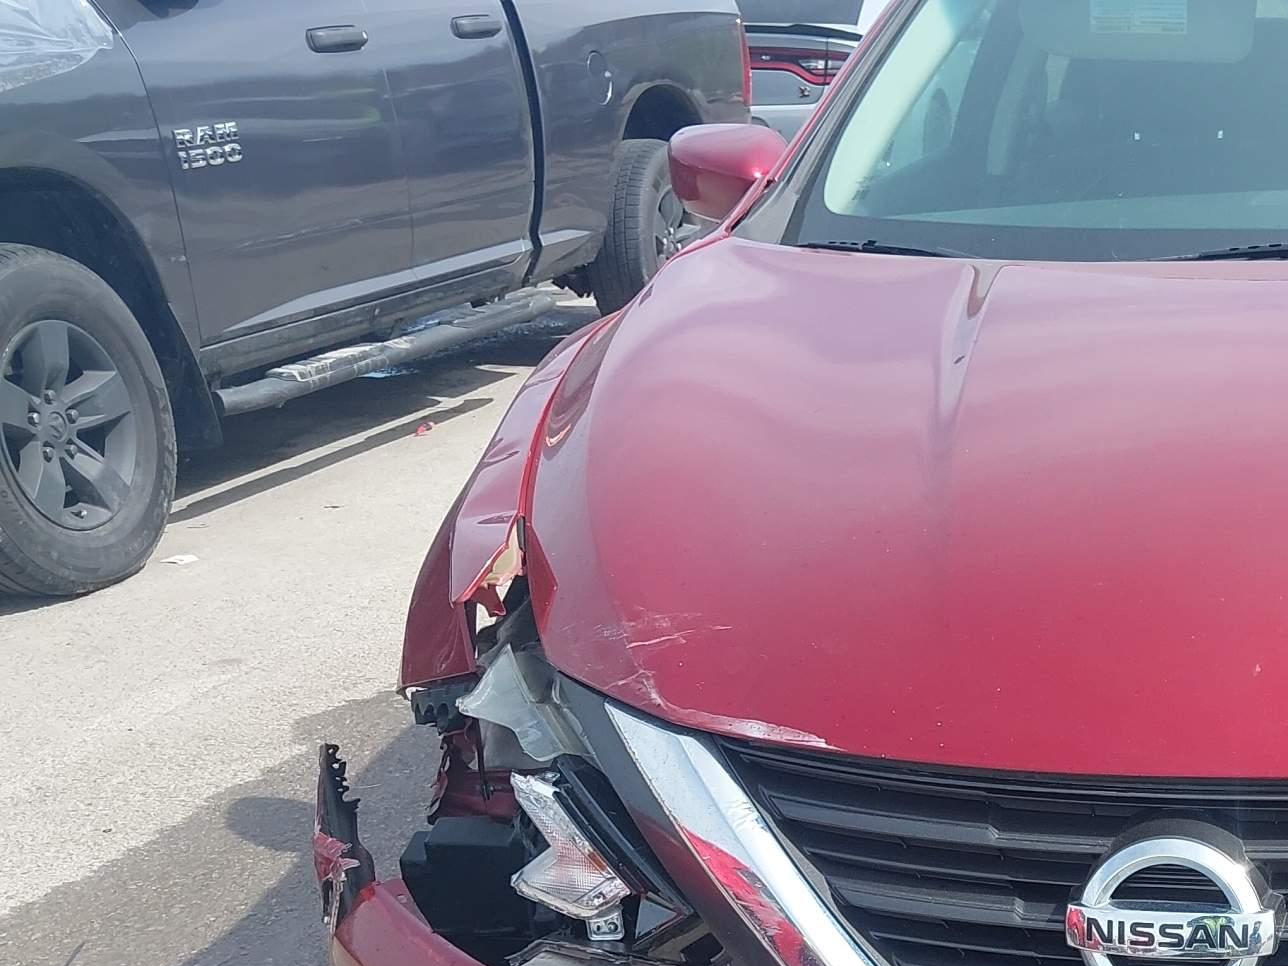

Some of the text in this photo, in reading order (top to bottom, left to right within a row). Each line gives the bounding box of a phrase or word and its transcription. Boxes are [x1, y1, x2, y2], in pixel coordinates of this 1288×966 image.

[173, 121, 240, 148] RAM
[177, 143, 243, 170] 1500
[1086, 917, 1249, 950] NISSAN
